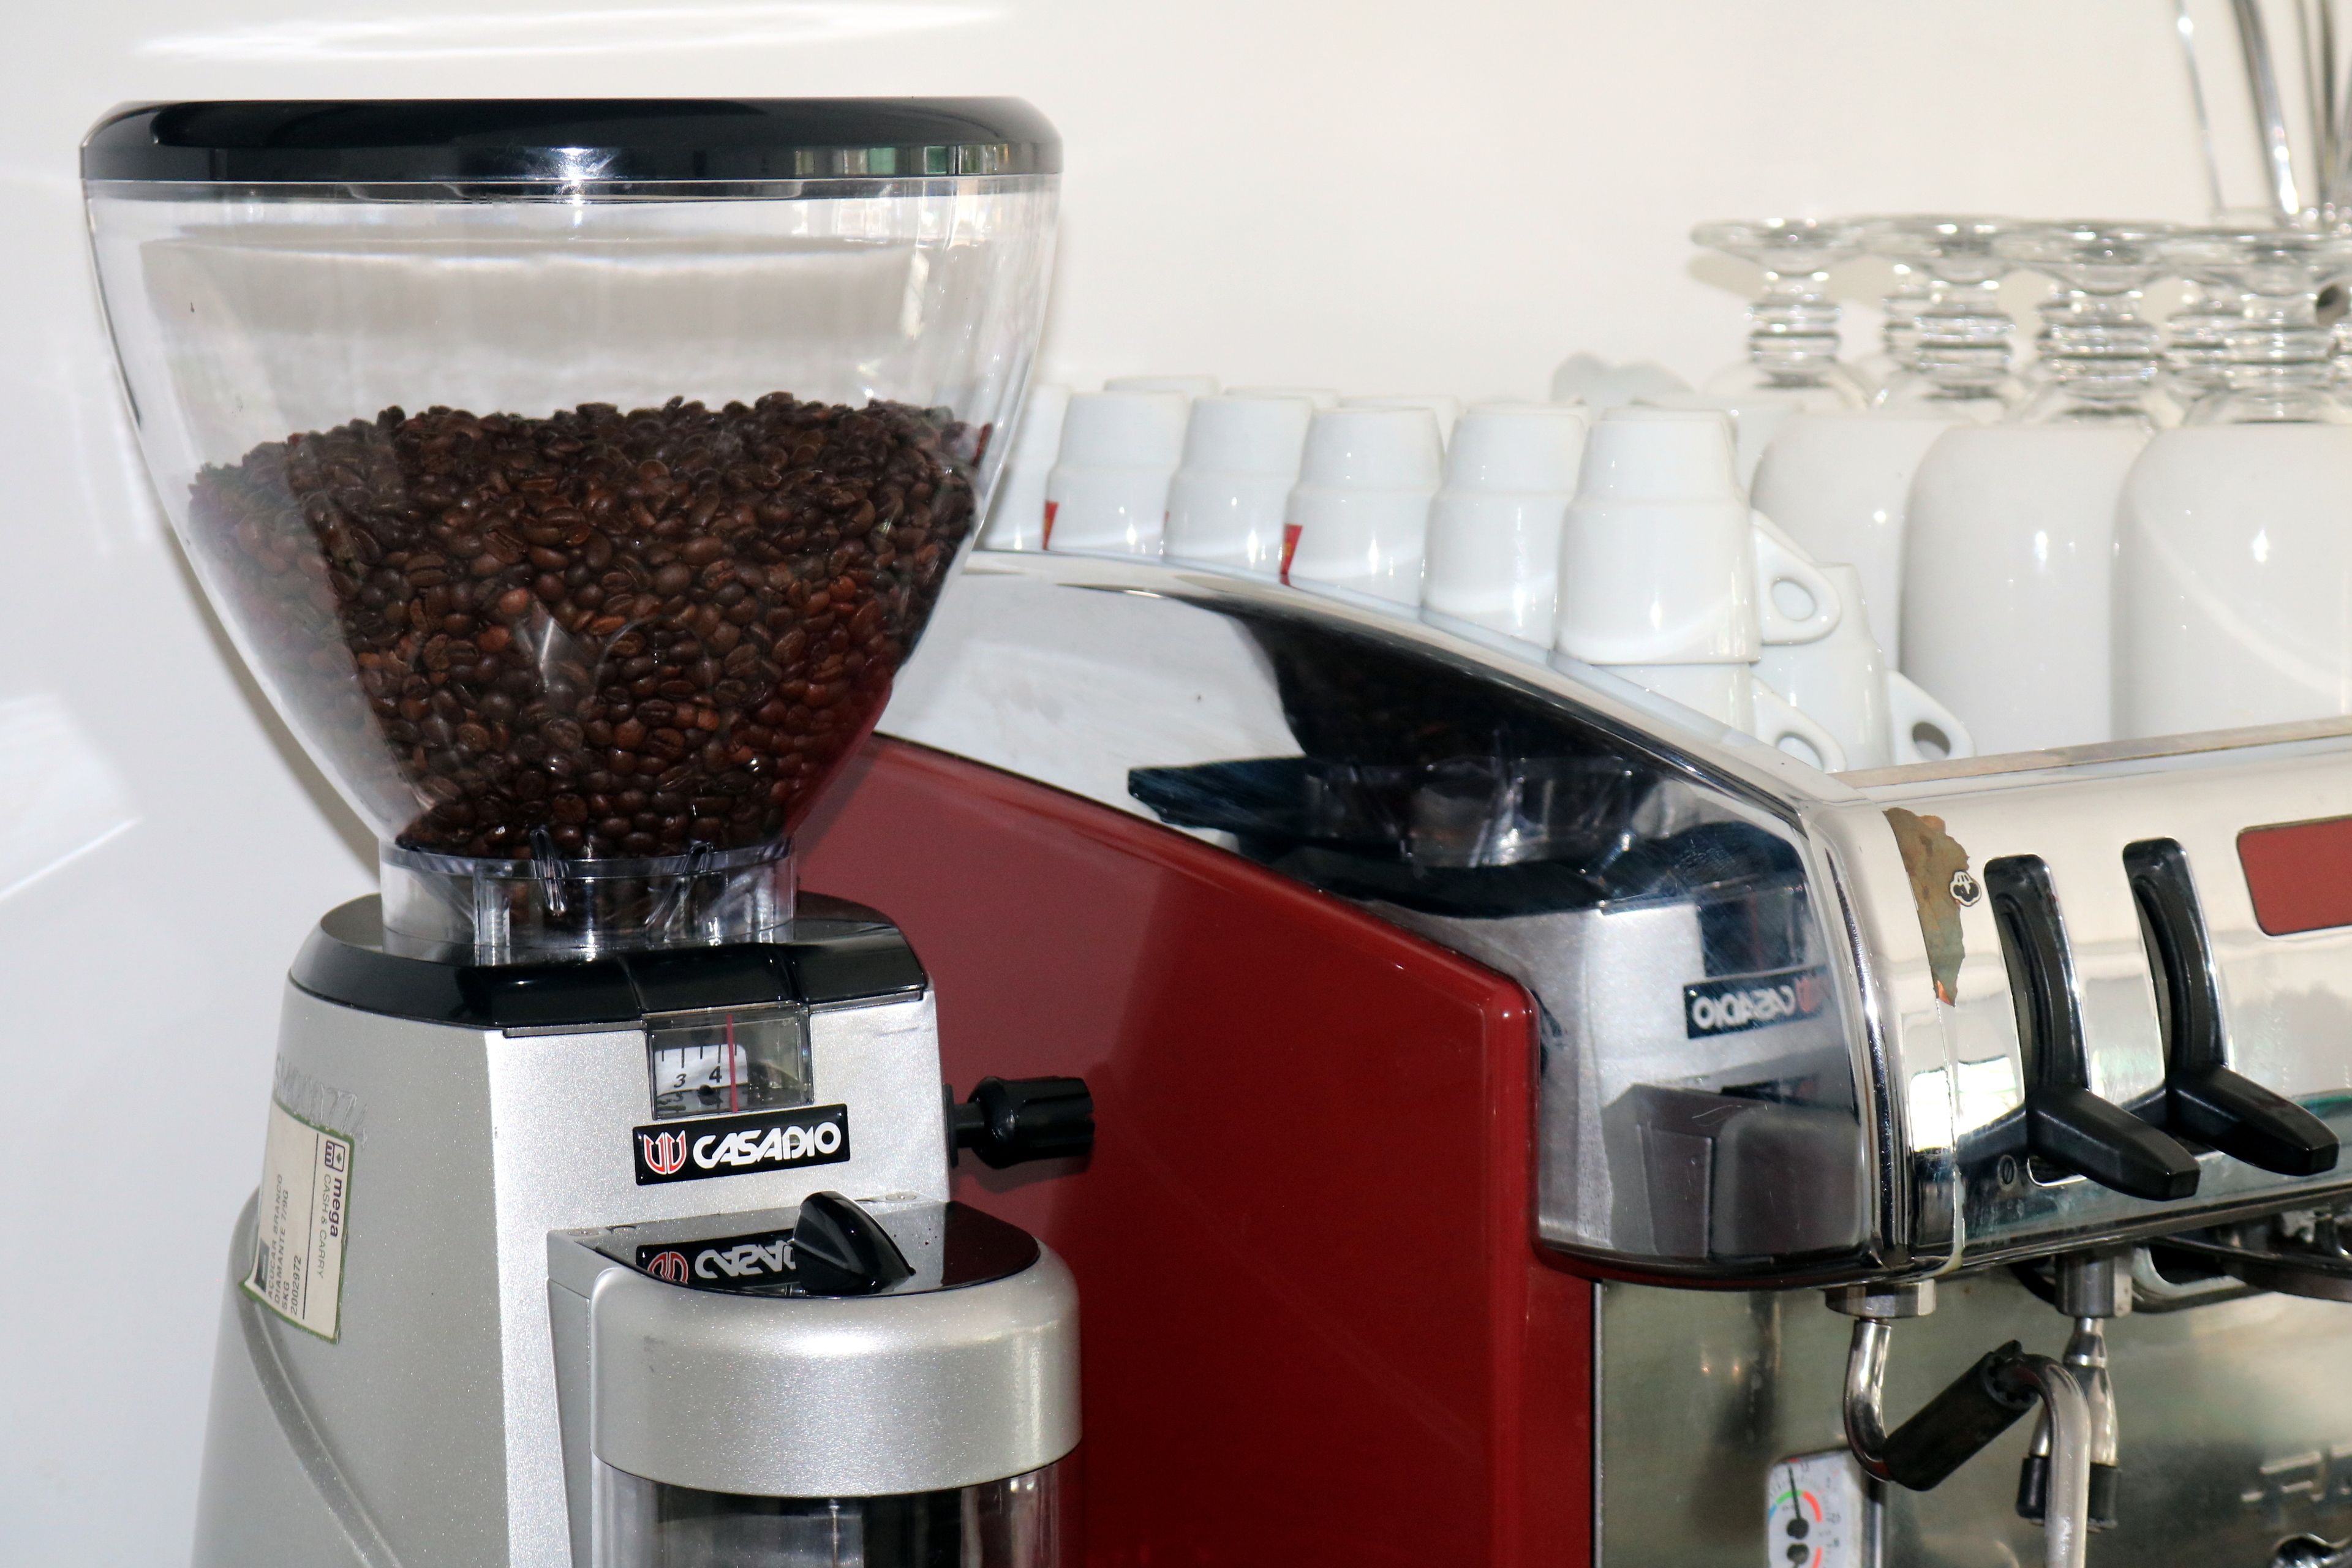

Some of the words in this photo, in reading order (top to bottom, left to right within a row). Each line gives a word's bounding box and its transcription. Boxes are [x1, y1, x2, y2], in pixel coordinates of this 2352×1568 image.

[674, 1073, 687, 1088] 3
[709, 1066, 722, 1083] 4
[693, 1121, 842, 1169] CASADIO
[273, 1174, 282, 1234] BRANCO
[322, 1174, 331, 1213] CASH
[329, 1177, 342, 1237] mega
[321, 1216, 328, 1224] &
[274, 1228, 285, 1305] DIAMANTE
[317, 1229, 326, 1279] CARRY
[291, 1254, 301, 1316] 2002972
